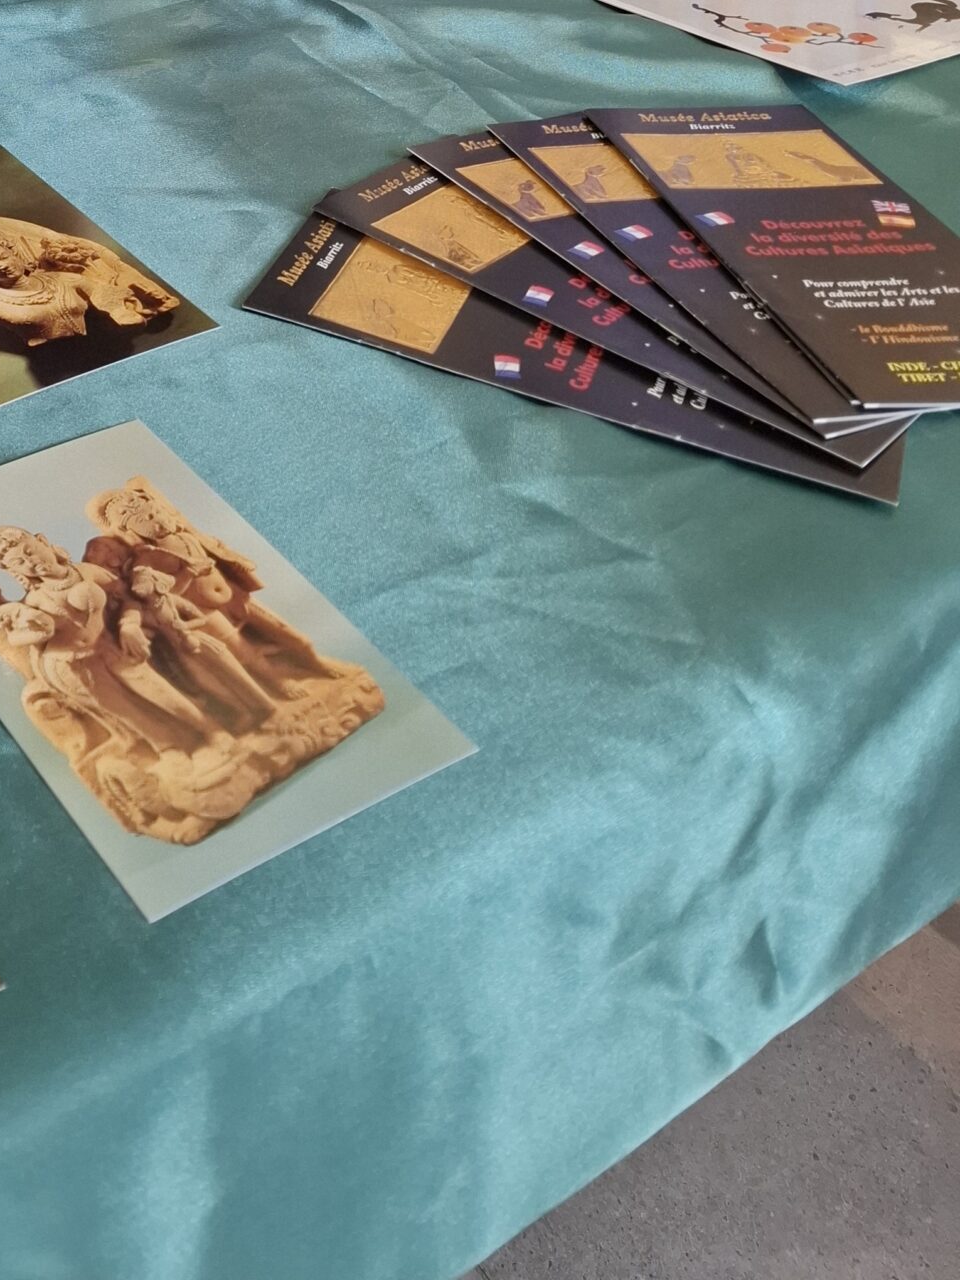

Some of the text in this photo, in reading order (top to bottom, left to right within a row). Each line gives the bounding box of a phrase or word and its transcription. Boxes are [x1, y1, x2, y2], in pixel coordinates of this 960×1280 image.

[637, 111, 772, 123] Musée Asiatica
[541, 122, 593, 135] Musé
[689, 122, 736, 130] Biarritz
[357, 178, 404, 202] Musée
[403, 175, 439, 196] Biarritz
[761, 219, 866, 230] Découvrez
[750, 229, 903, 243] la diversité des
[276, 219, 338, 287] Musée Asiati
[316, 240, 345, 271] Biarritz
[670, 244, 695, 256] la
[744, 242, 937, 257] Cultures Asiatiques
[668, 258, 719, 269] Cultu
[801, 275, 910, 290] Pour comprendre
[813, 284, 960, 298] et admirer les Arts et les
[576, 297, 601, 309] la
[823, 299, 880, 308] Cultures
[881, 298, 897, 307] de
[908, 297, 936, 306] Asie
[871, 323, 949, 334] Bouddhisme
[882, 334, 959, 345] Hindouisme
[543, 356, 567, 372] la
[568, 346, 603, 392] Culture
[886, 361, 931, 372] INDE
[897, 372, 947, 383] TIBET
